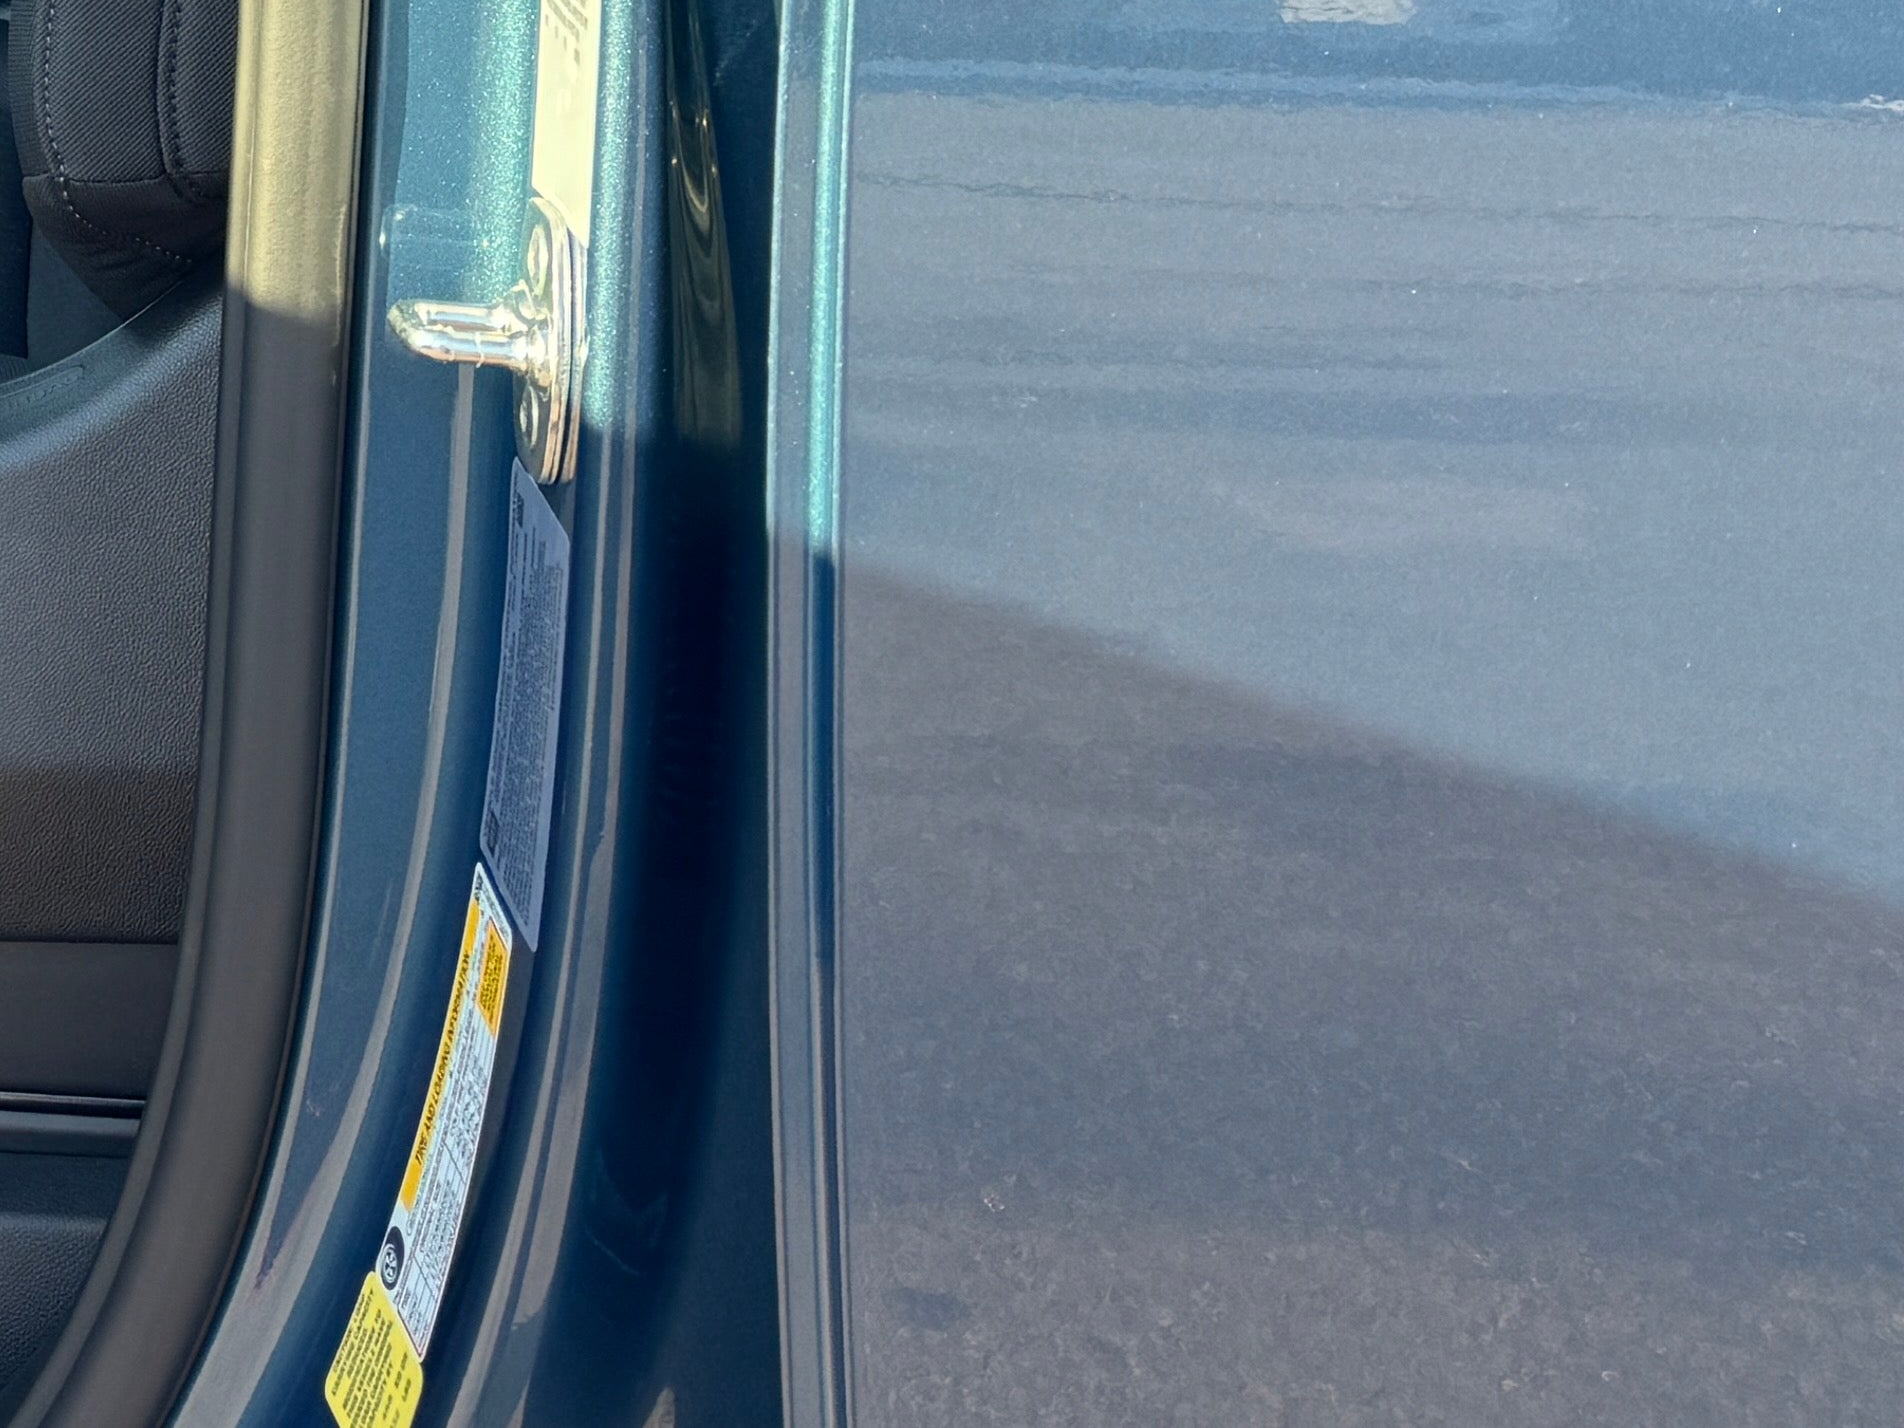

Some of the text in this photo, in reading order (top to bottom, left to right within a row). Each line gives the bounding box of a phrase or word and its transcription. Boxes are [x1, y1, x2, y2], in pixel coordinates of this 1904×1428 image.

[415, 954, 470, 1165] TIRE AND LOADING INFORMATION
